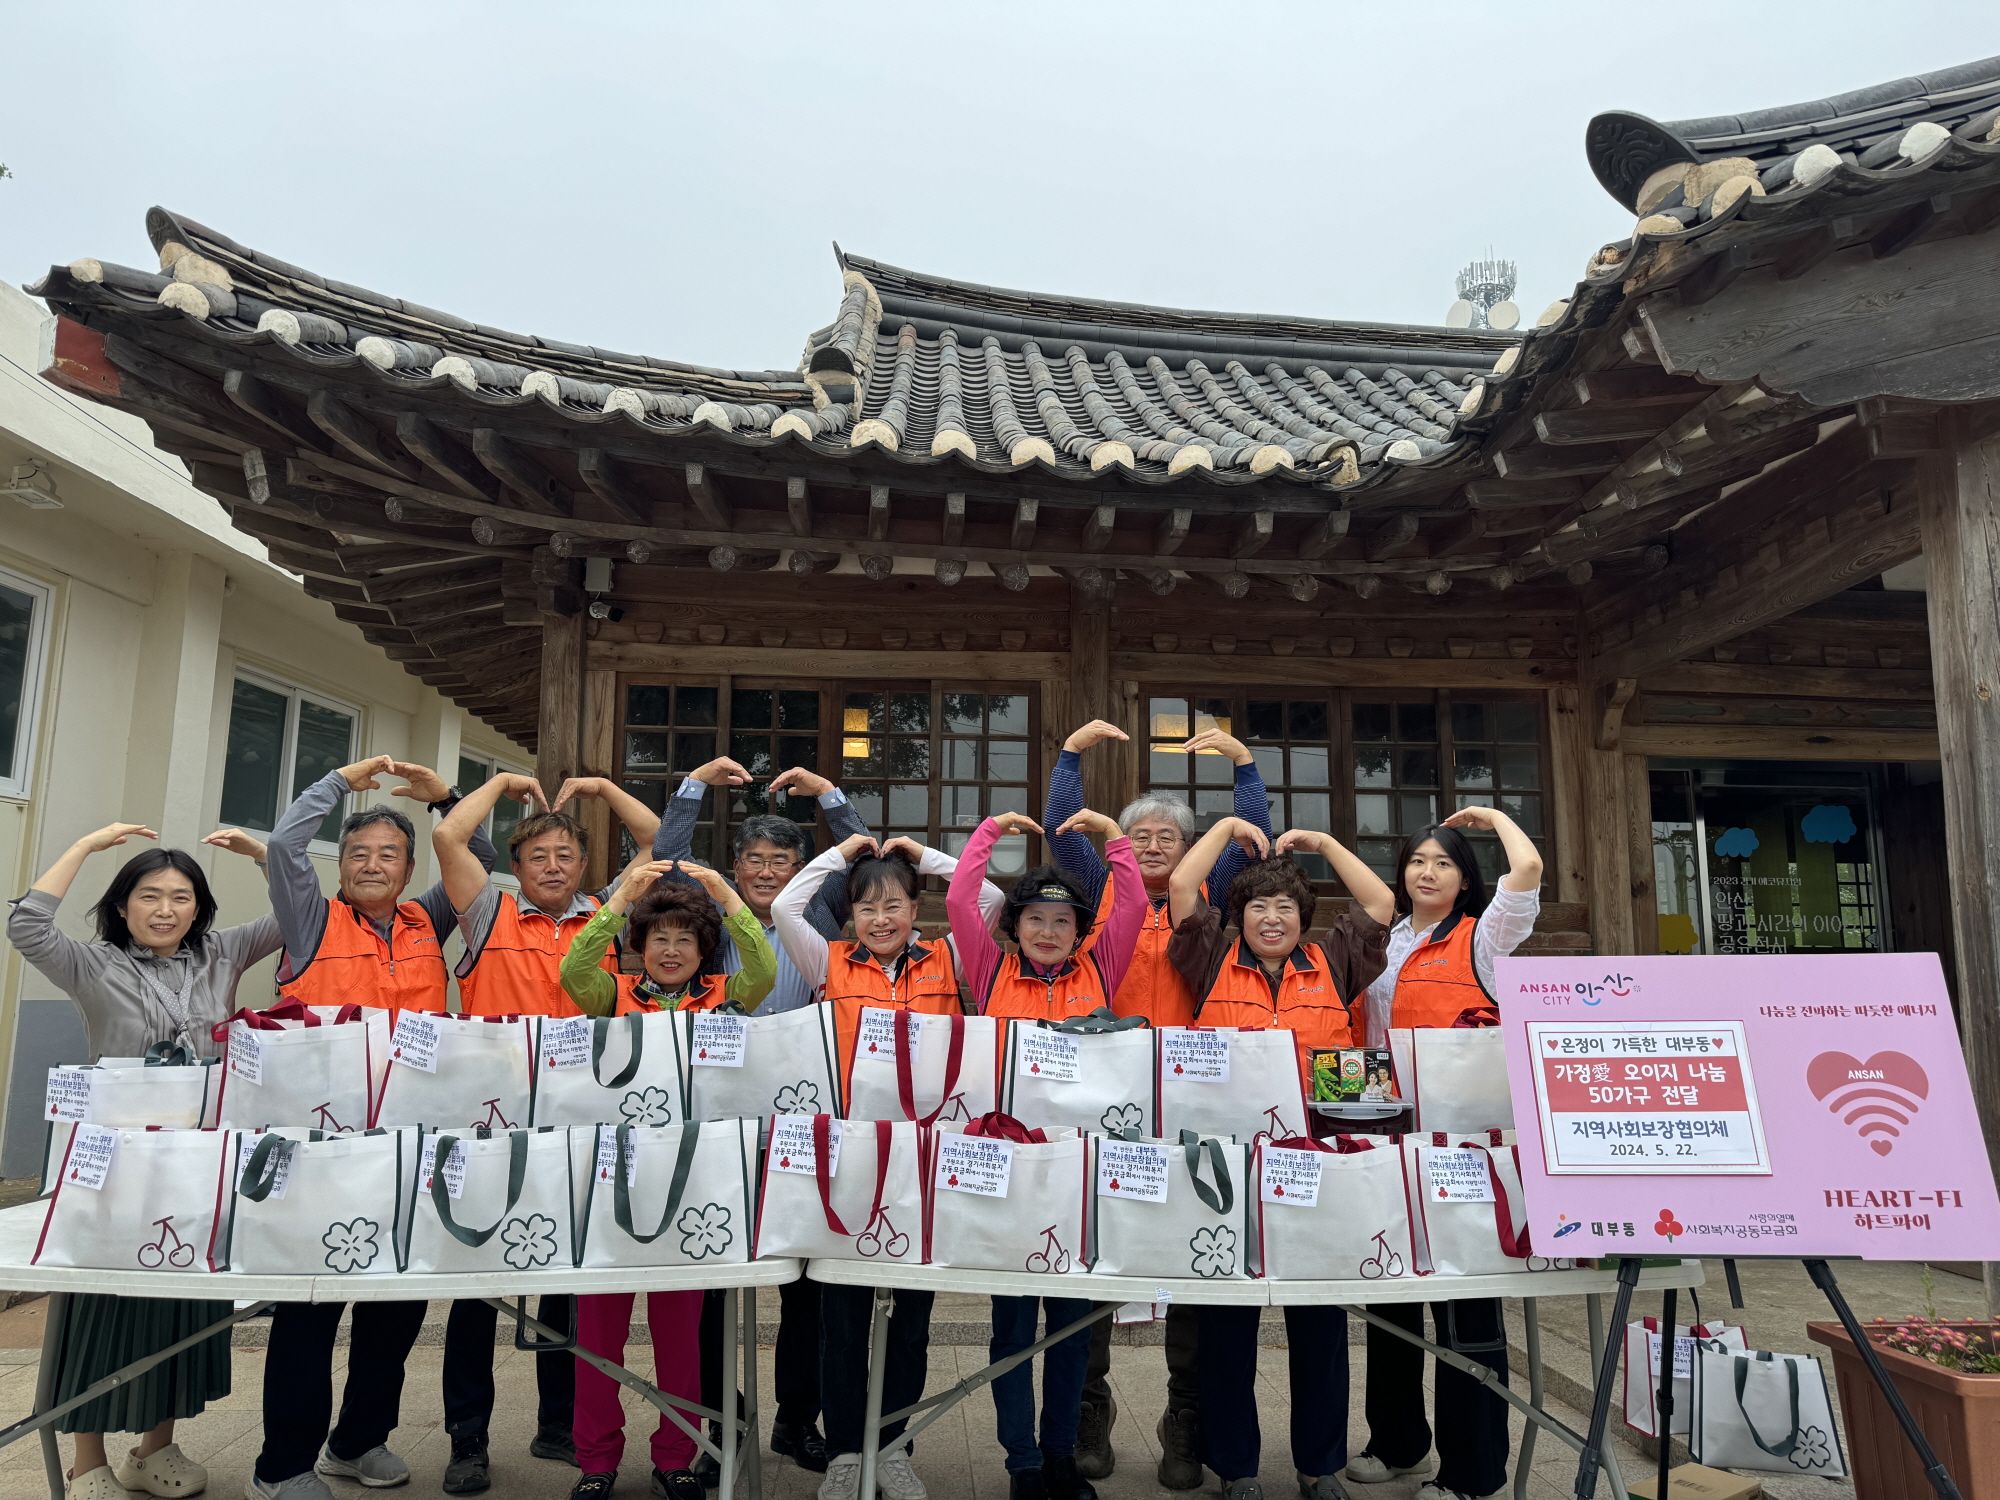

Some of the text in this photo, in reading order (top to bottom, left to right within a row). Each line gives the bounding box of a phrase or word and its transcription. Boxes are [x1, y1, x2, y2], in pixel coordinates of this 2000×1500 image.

[1713, 877, 1738, 885] 2023
[1757, 915, 1807, 932] 시간의
[1520, 984, 1571, 993] ANSAN
[1543, 996, 1571, 1006] CITY
[1759, 1005, 1797, 1018] 나눔을
[1800, 1005, 1851, 1018] 전파하는
[1897, 1004, 1937, 1017] 에너지
[865, 1018, 919, 1031] 지역사회보의체
[1198, 1033, 1218, 1041] 대부동
[1166, 1040, 1227, 1050] 지역사회보장협의체
[1561, 1036, 1711, 1054] 온정이 가득한 대부동
[1318, 1055, 1333, 1063] 5+1
[1554, 1063, 1726, 1084] 가정愛 오이지 나눔
[1848, 1069, 1884, 1080] ANSAN
[1589, 1086, 1699, 1106] 50가구 전달
[1572, 1119, 1729, 1140] 지역사회보장협의체
[777, 1130, 839, 1144] 지역사회보체
[800, 1142, 834, 1150] 경기지
[978, 1143, 999, 1153] 대부동
[1136, 1146, 1157, 1156] 대부동
[1610, 1144, 1698, 1157] 2024. 5. 22.
[943, 1148, 1007, 1164] 지역사회보장협의체
[1103, 1152, 1166, 1167] 지역사회보장협의체
[941, 1165, 980, 1175] 공동모금회에서
[968, 1160, 1003, 1171] 경기사회복지
[1127, 1164, 1162, 1174] 경기사회복지
[1102, 1169, 1140, 1179] 공동모금회에서
[1823, 1189, 1963, 1208] HEART-FI
[1748, 1213, 1795, 1223] 사랑의열매
[1853, 1213, 1931, 1231] 하트파이
[1591, 1222, 1635, 1237] 대부동
[1686, 1224, 1798, 1239] 사회복지공동모금회
